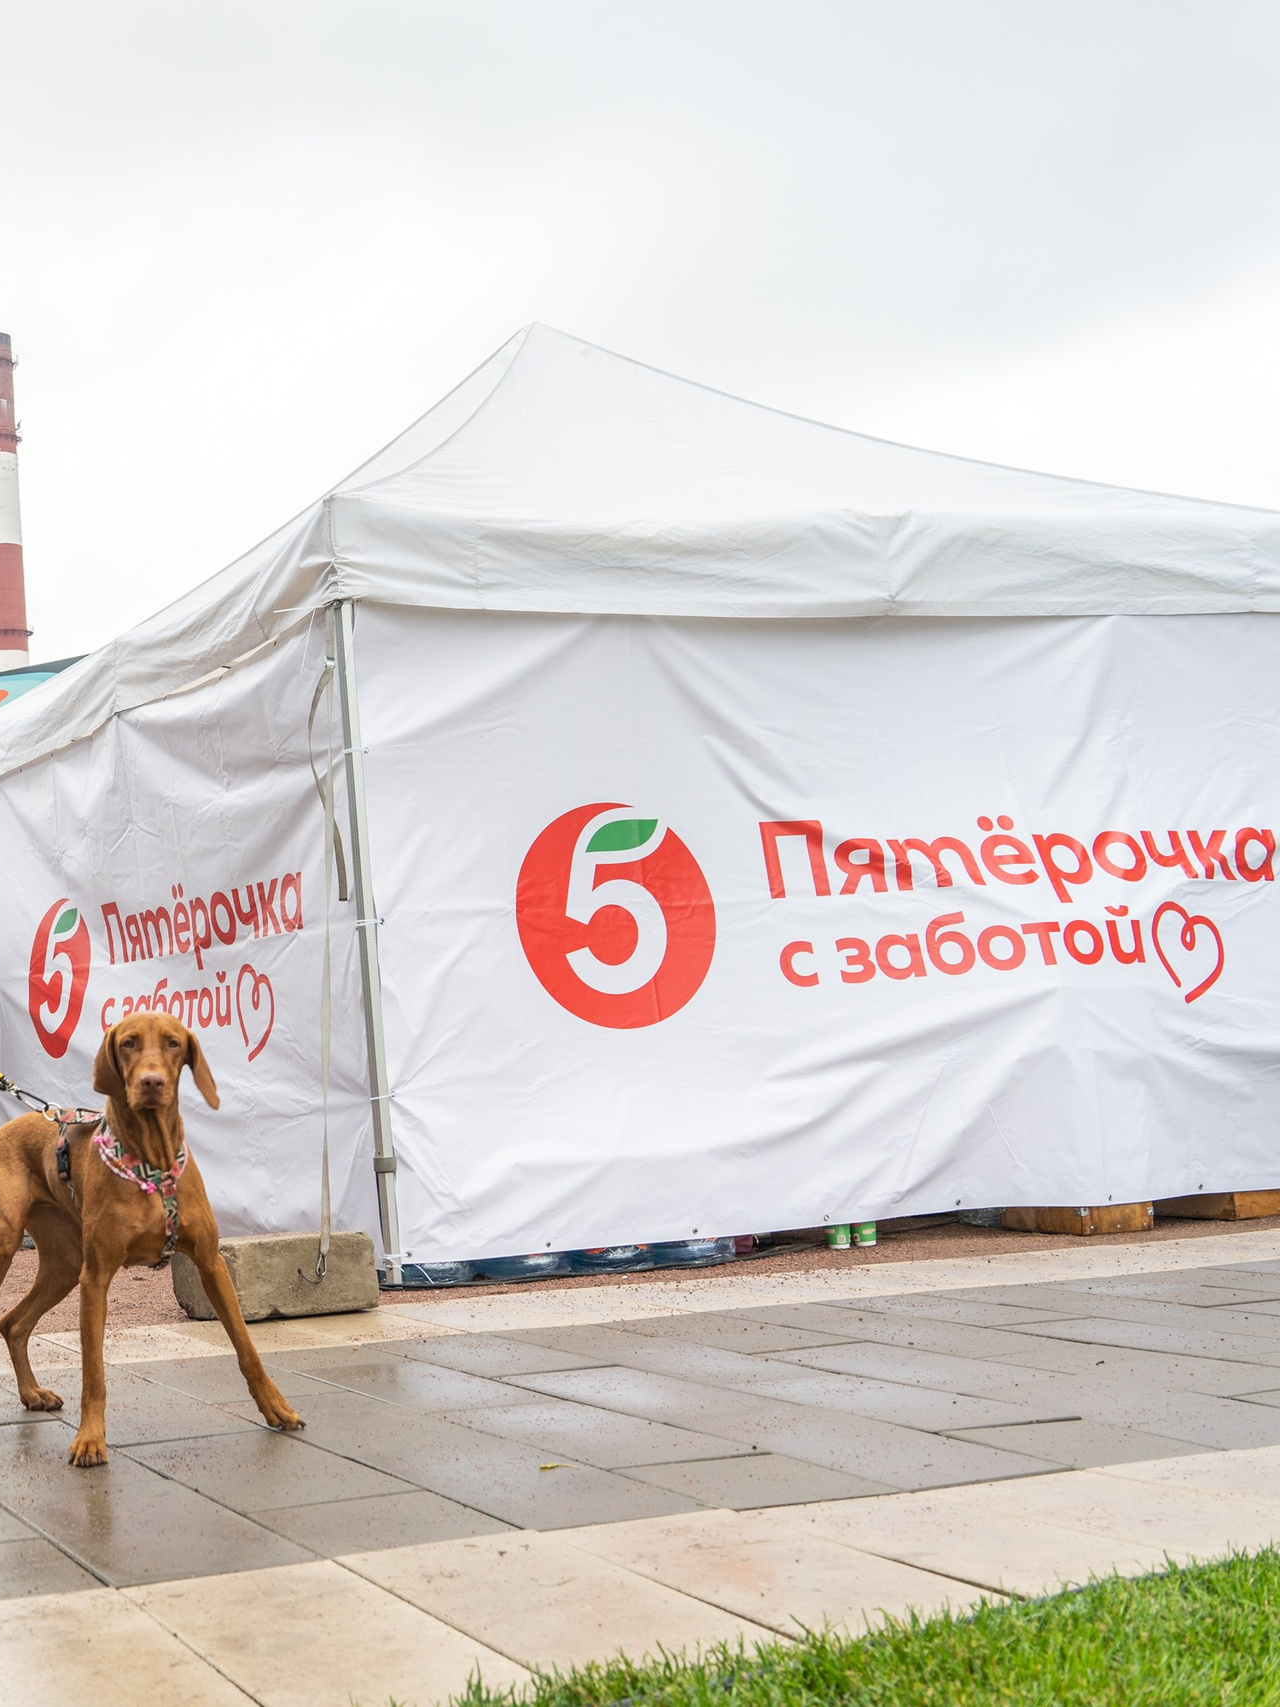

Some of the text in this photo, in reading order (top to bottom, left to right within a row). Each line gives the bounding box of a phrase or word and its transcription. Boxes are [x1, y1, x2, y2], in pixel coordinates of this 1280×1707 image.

[758, 815, 1277, 904] Пятёрочка
[100, 871, 304, 971] Пятёрочка
[779, 904, 1147, 988] с заботой
